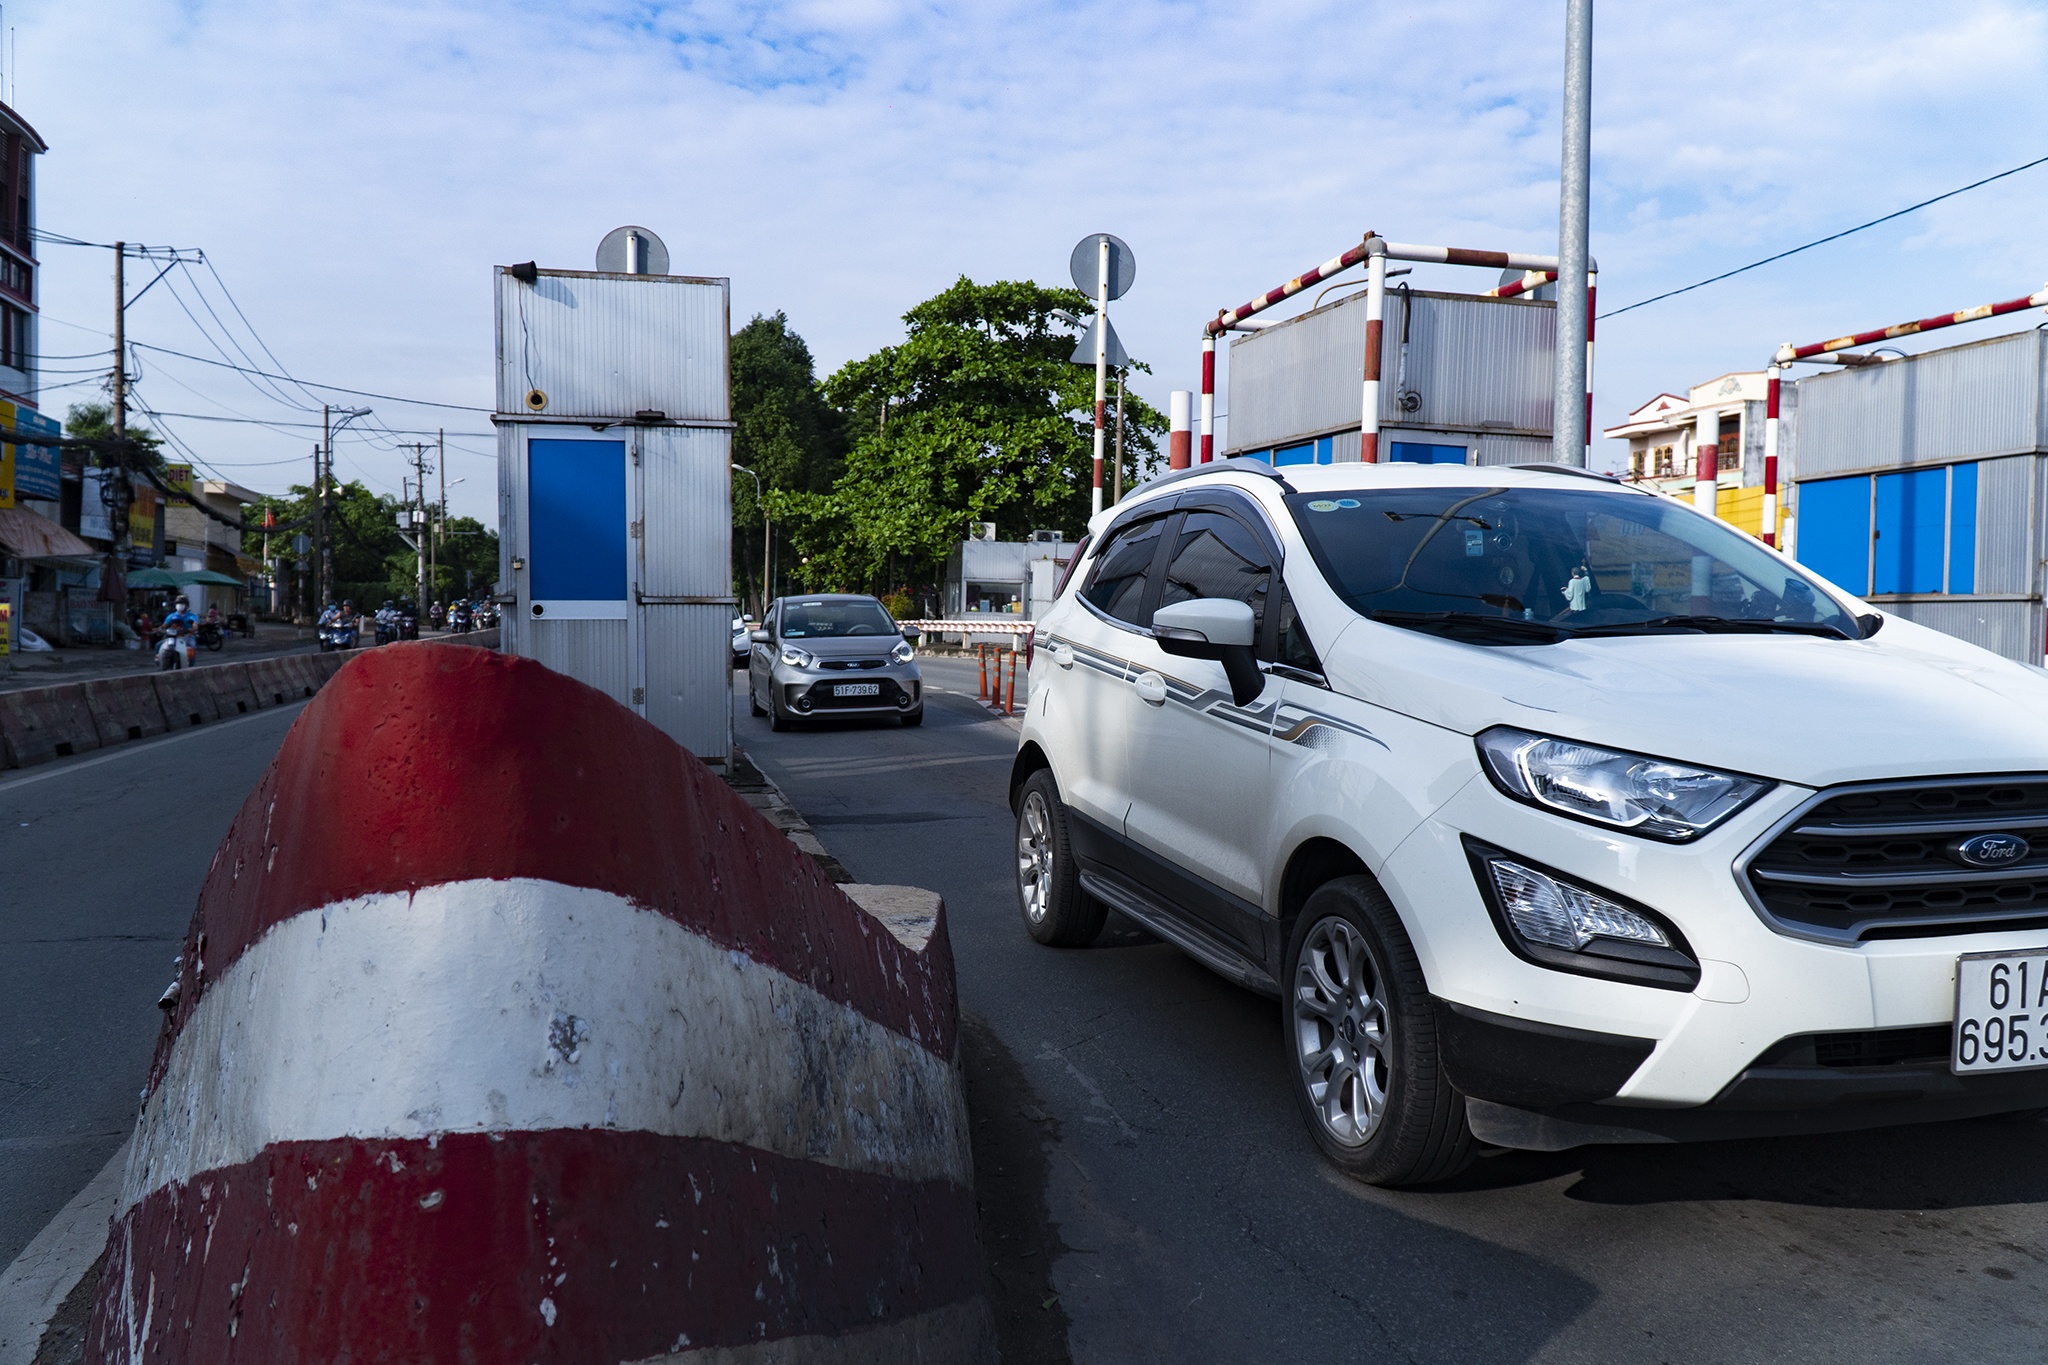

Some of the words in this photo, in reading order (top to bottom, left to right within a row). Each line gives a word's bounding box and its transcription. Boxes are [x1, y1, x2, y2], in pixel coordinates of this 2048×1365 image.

[168, 466, 190, 484] DIỆT
[1979, 839, 2017, 859] Ford
[1989, 960, 2048, 1011] 61A
